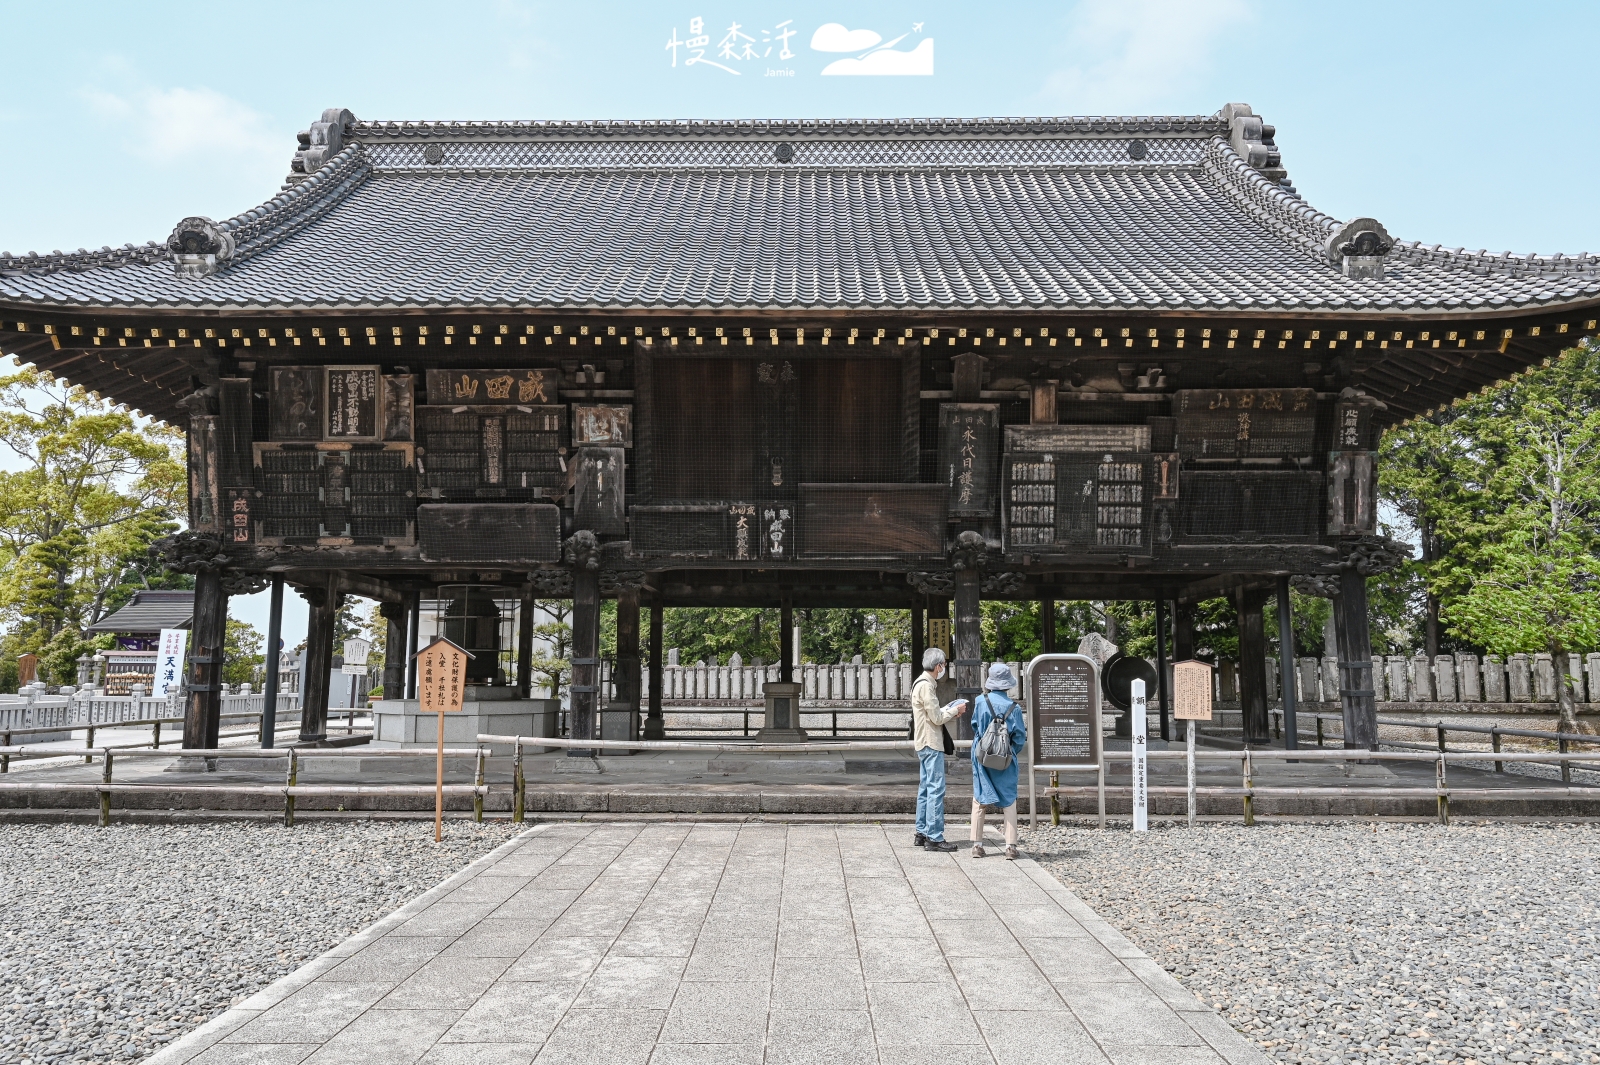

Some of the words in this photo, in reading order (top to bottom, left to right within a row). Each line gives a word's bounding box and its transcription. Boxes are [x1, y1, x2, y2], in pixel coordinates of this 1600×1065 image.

[958, 425, 977, 505] 永代日護摩
[425, 652, 433, 710] ご遠慮願います。
[438, 652, 447, 706] 入堂、千社札は
[451, 652, 459, 707] 文化財保護の為
